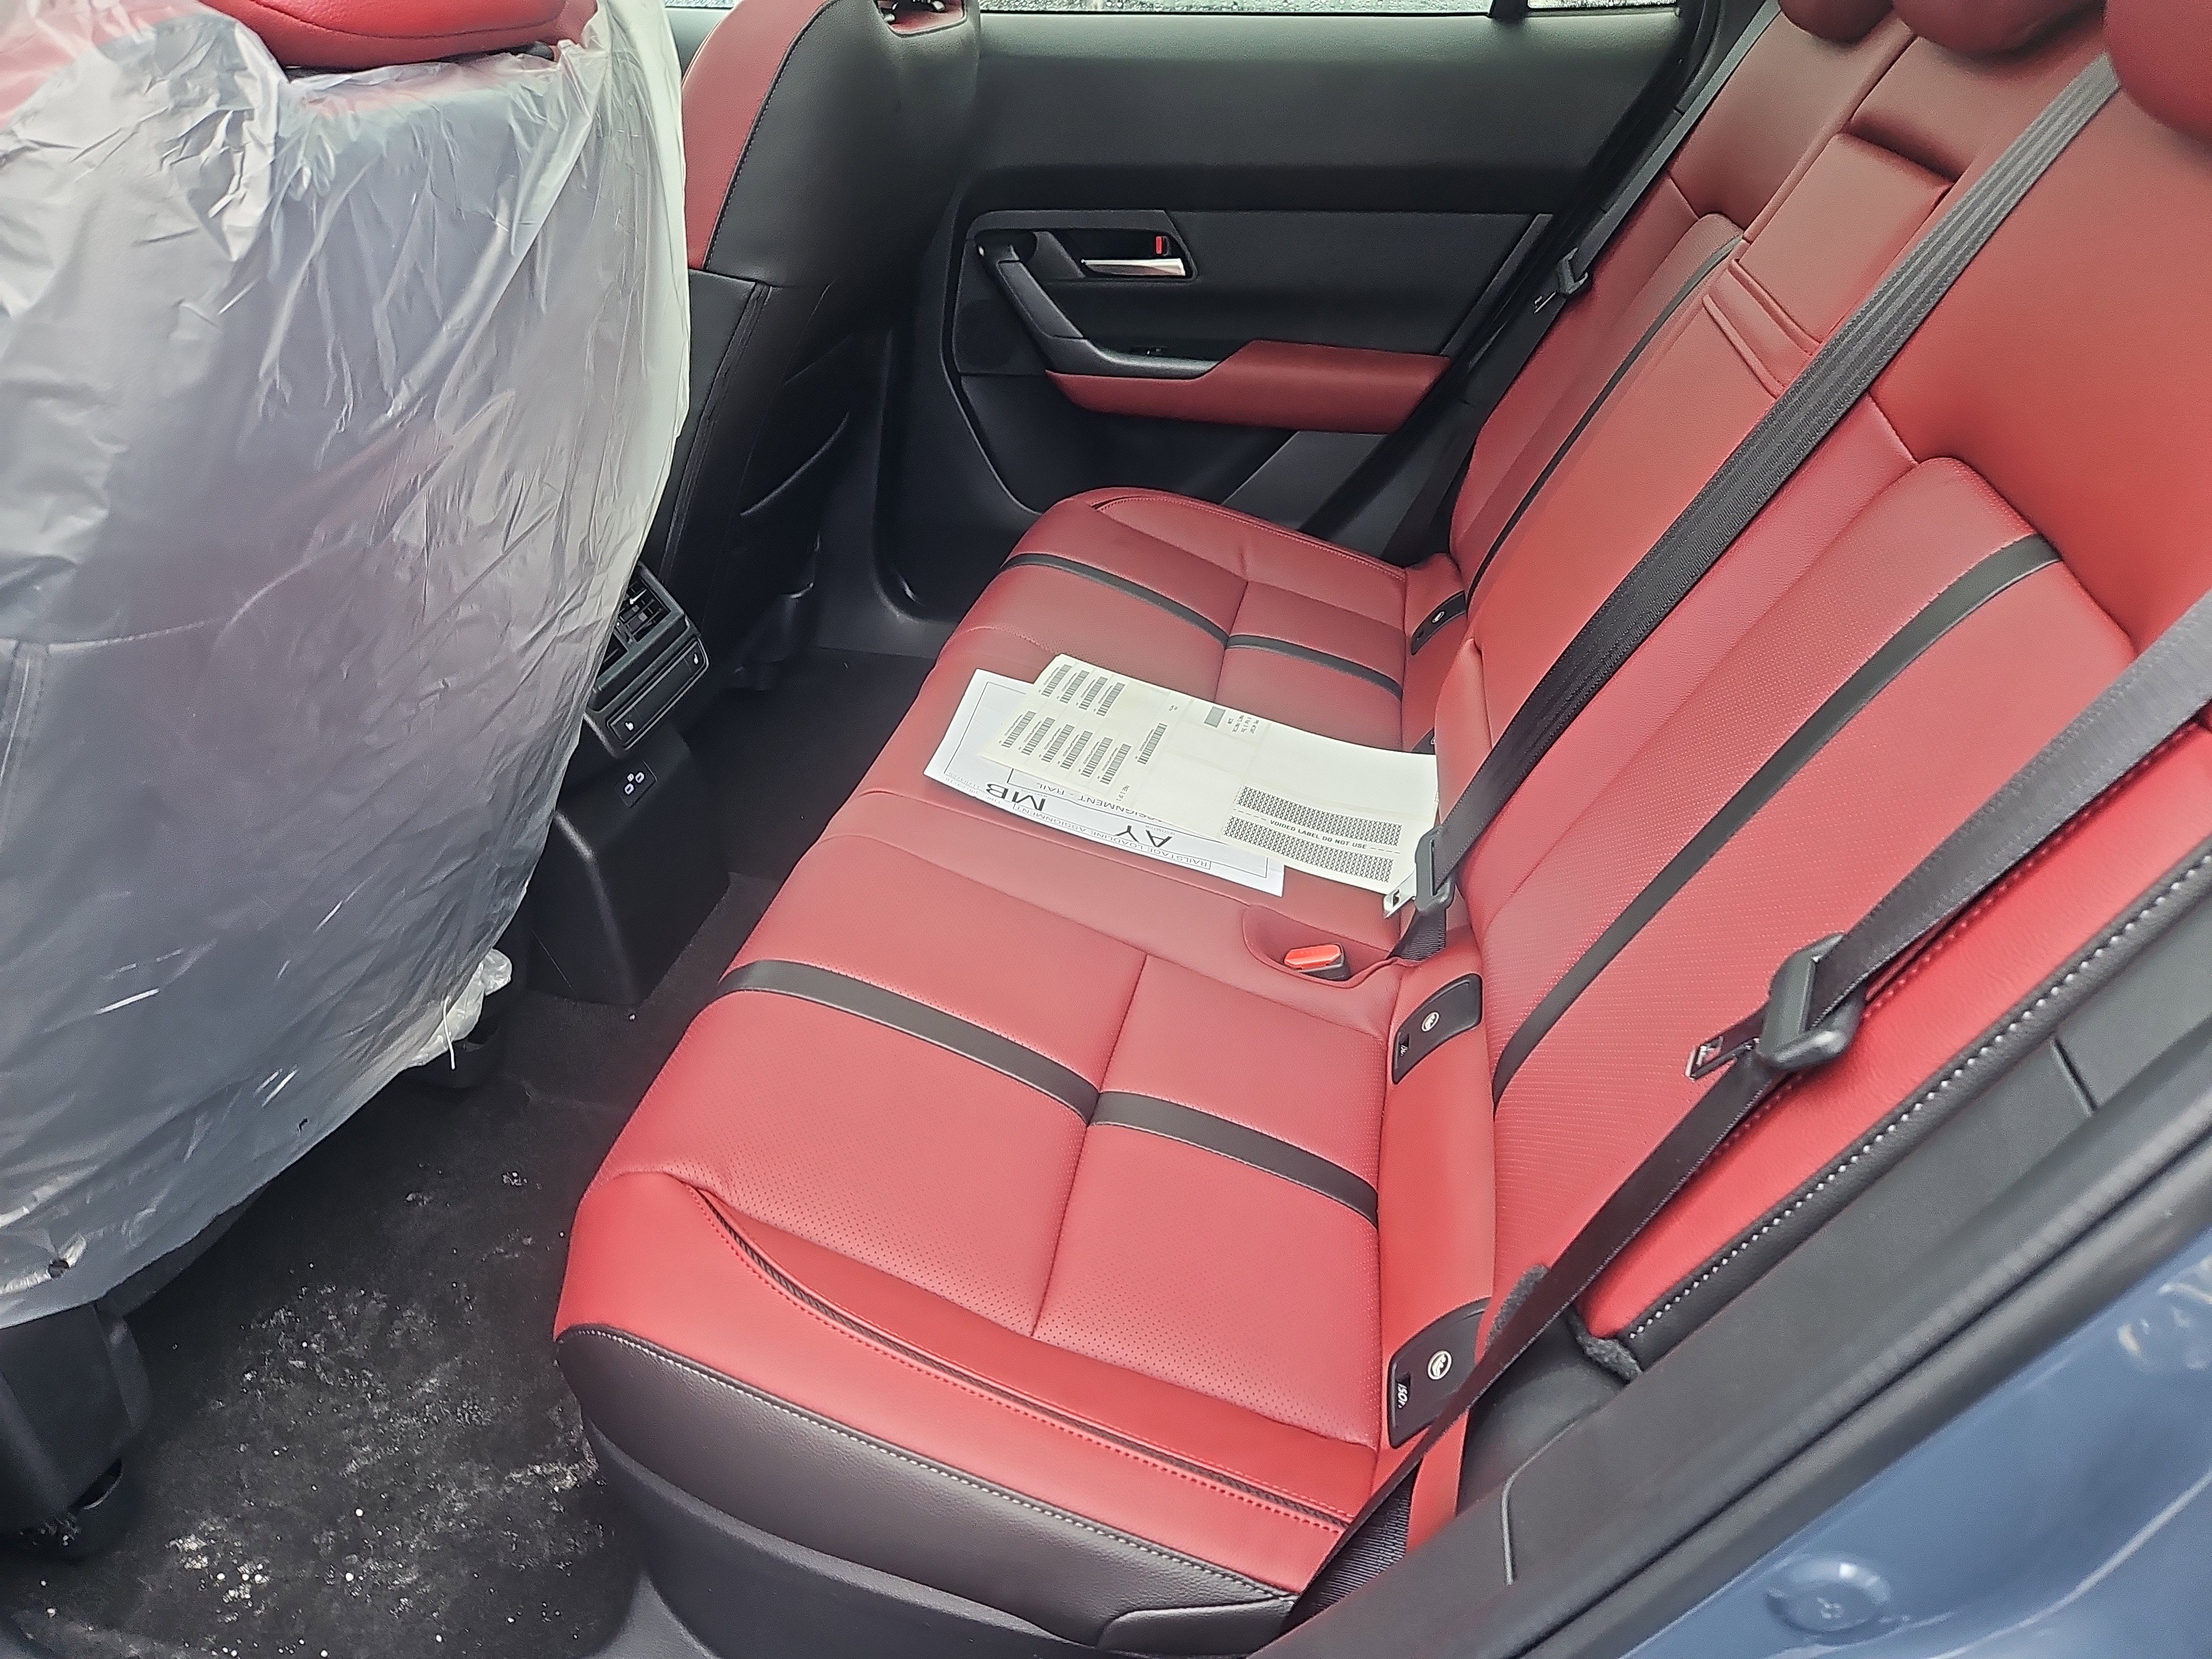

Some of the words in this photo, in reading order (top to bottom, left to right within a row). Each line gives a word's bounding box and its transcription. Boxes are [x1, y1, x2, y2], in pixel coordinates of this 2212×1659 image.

[986, 783, 1046, 812] MB
[1036, 782, 1065, 795] RAIL
[1115, 825, 1173, 847] AY
[1270, 819, 1296, 831] VOIDED
[1297, 828, 1320, 839] LABEL
